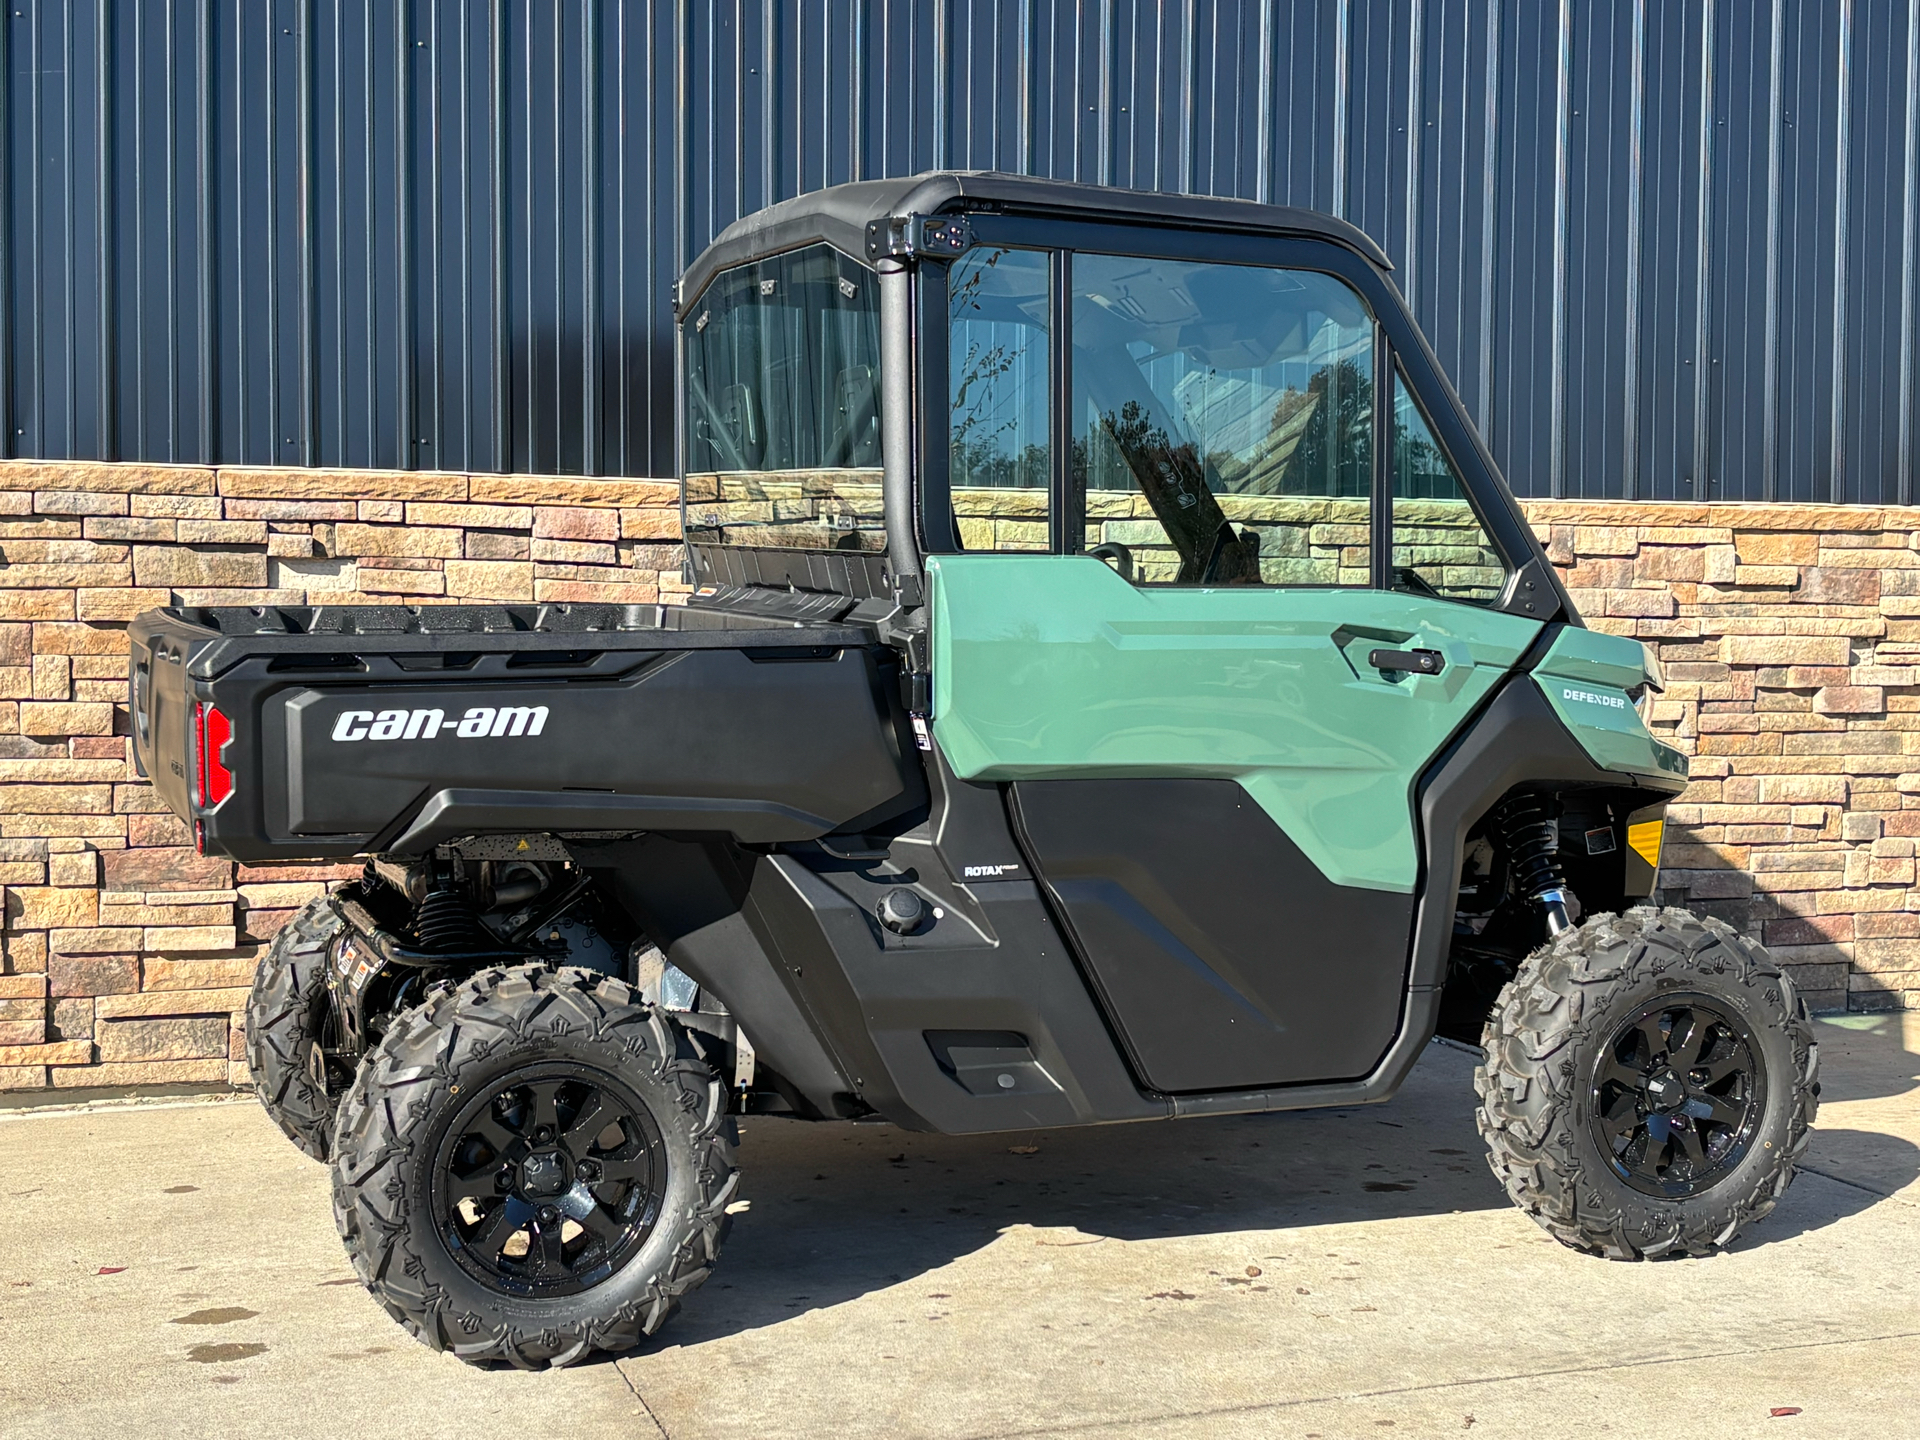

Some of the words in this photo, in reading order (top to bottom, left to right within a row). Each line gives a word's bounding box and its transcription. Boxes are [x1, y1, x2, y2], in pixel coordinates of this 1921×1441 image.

[1563, 688, 1625, 709] DEFENDER
[331, 705, 550, 741] can-am
[964, 865, 1003, 877] ROTAX
